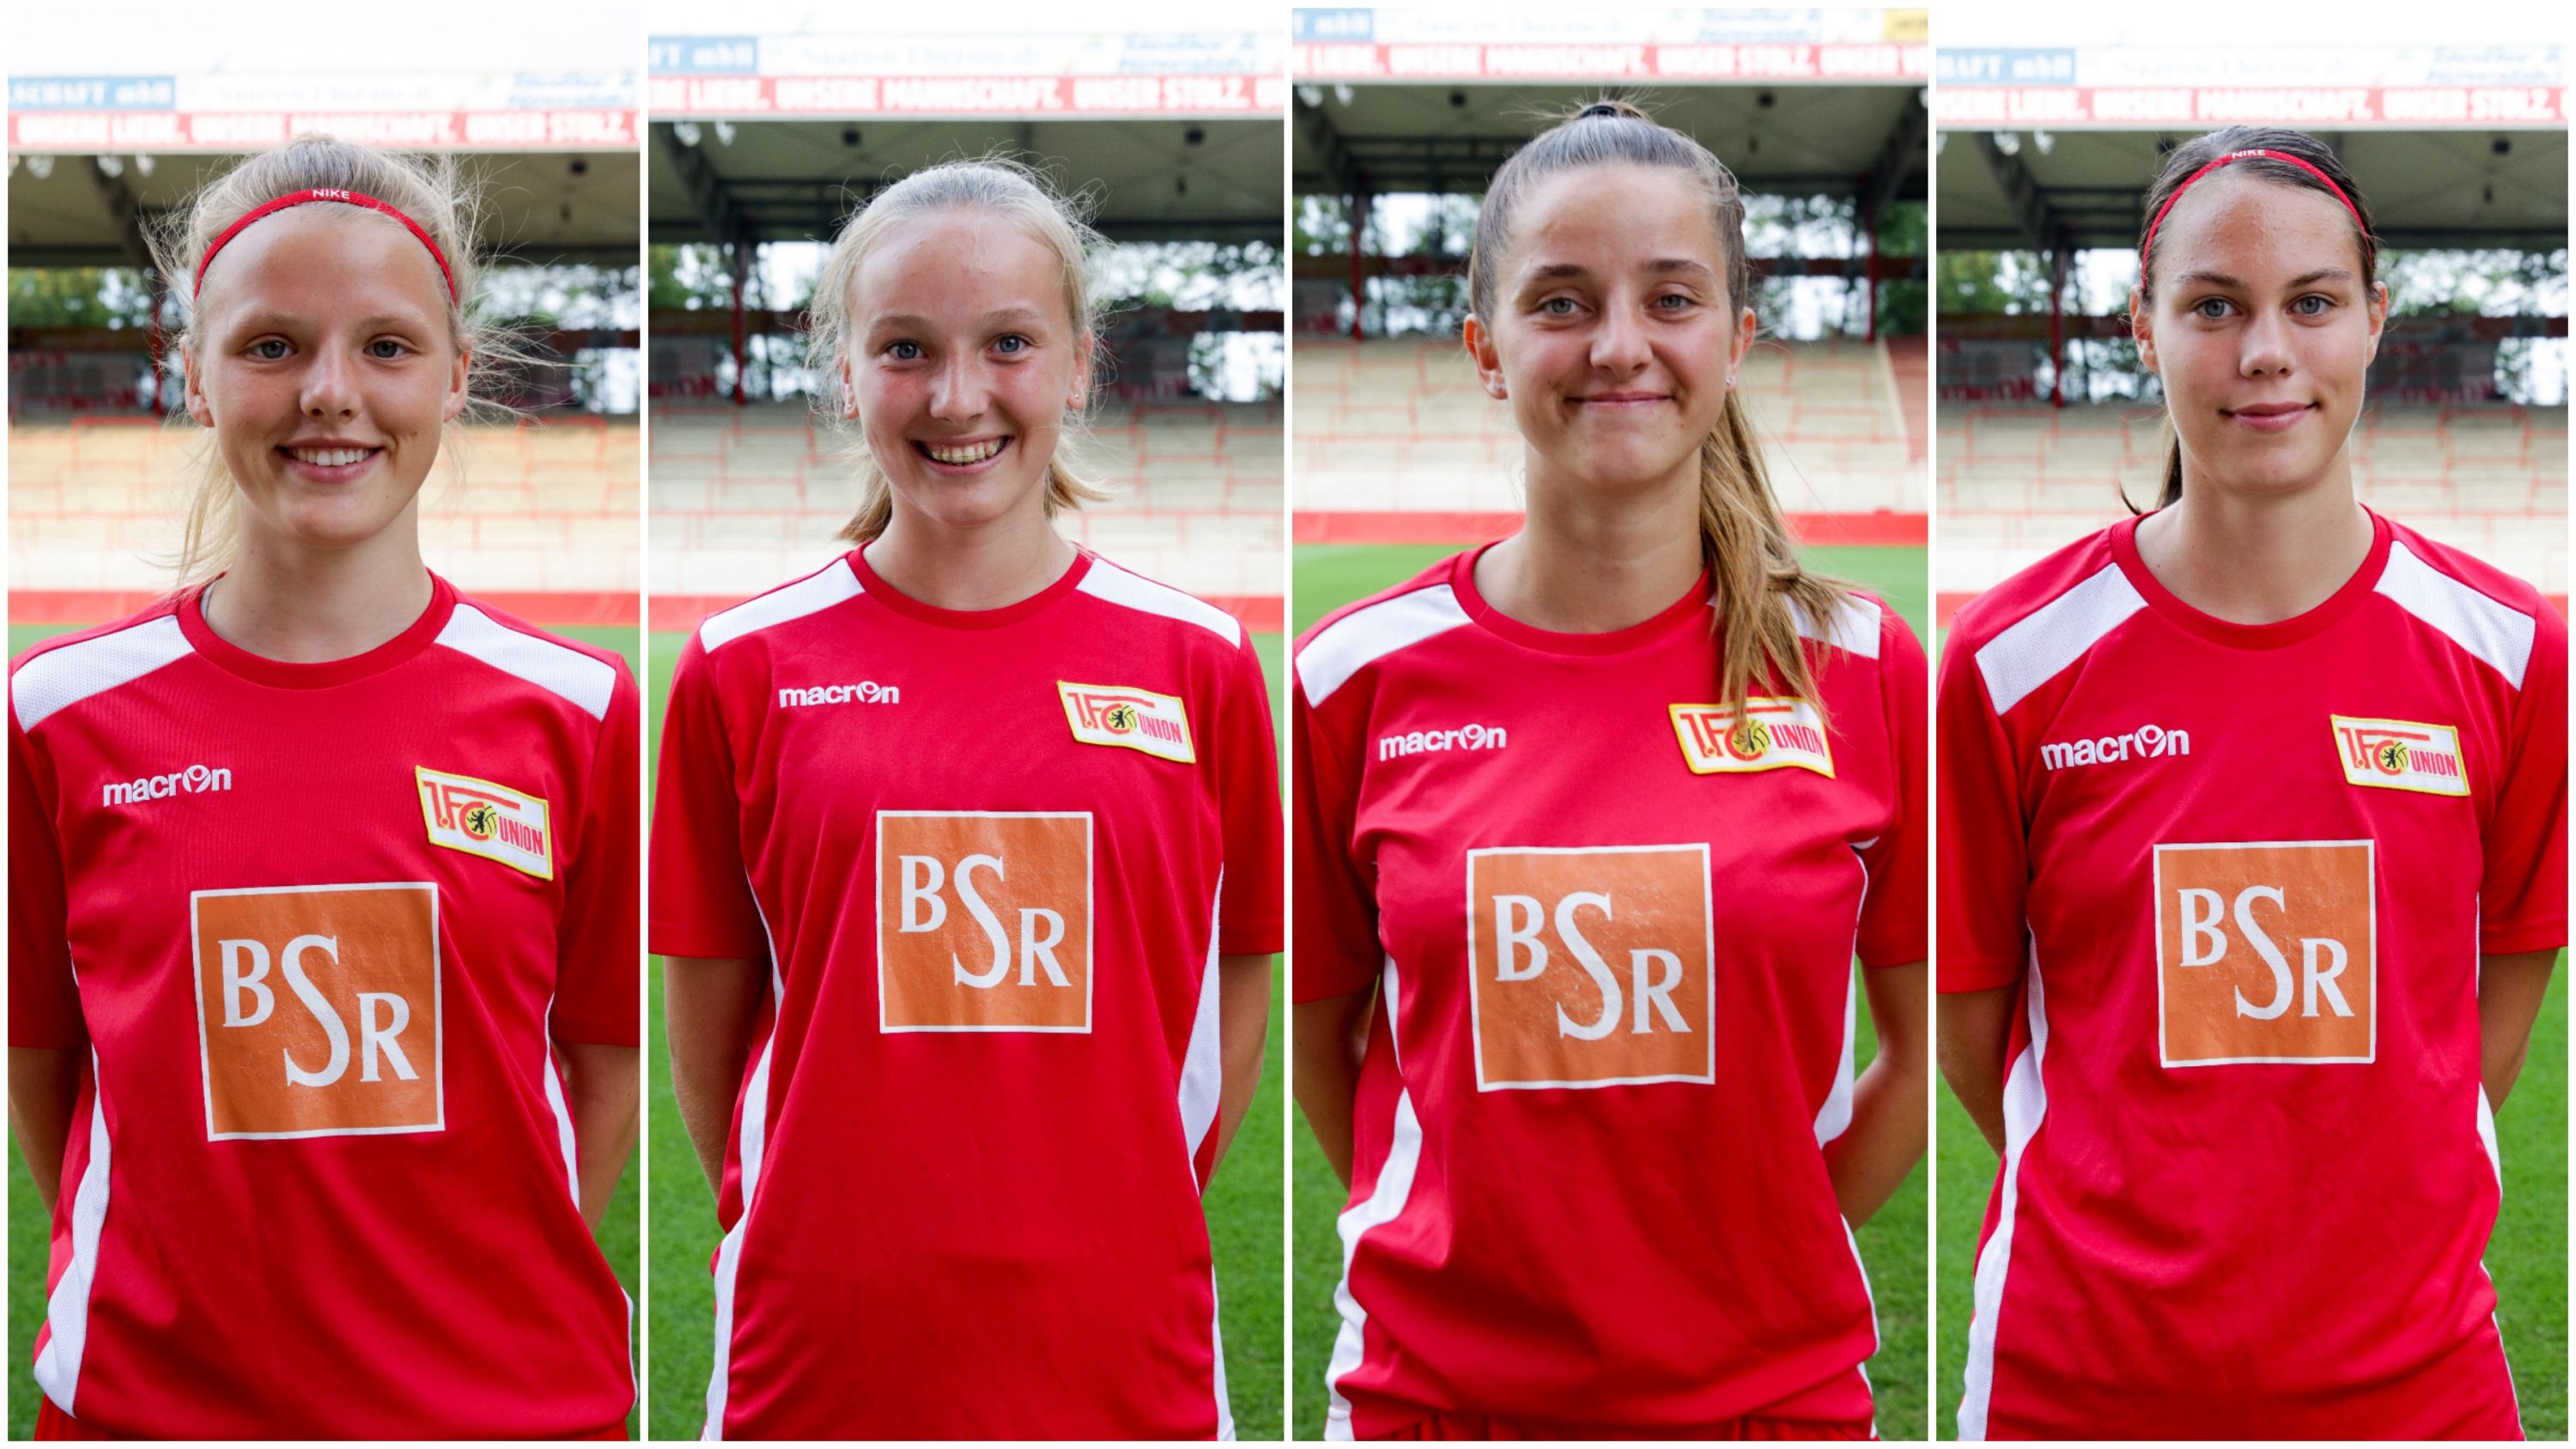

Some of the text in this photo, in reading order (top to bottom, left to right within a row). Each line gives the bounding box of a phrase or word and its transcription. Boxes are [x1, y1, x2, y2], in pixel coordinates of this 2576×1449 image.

[2232, 149, 2266, 159] NIKE
[312, 188, 350, 200] NIKE
[779, 680, 900, 710] macron
[1138, 712, 1182, 744] UNION
[1379, 723, 1507, 762] macron
[1768, 724, 1826, 758] UNION
[2040, 724, 2190, 771] macron
[2409, 749, 2459, 778] UNION
[102, 764, 233, 808] macron
[498, 815, 546, 857] UNION
[898, 853, 1072, 989] BSR
[1492, 890, 1693, 1041] BSR
[2177, 884, 2356, 1021] BSR
[217, 933, 420, 1088] BSR
